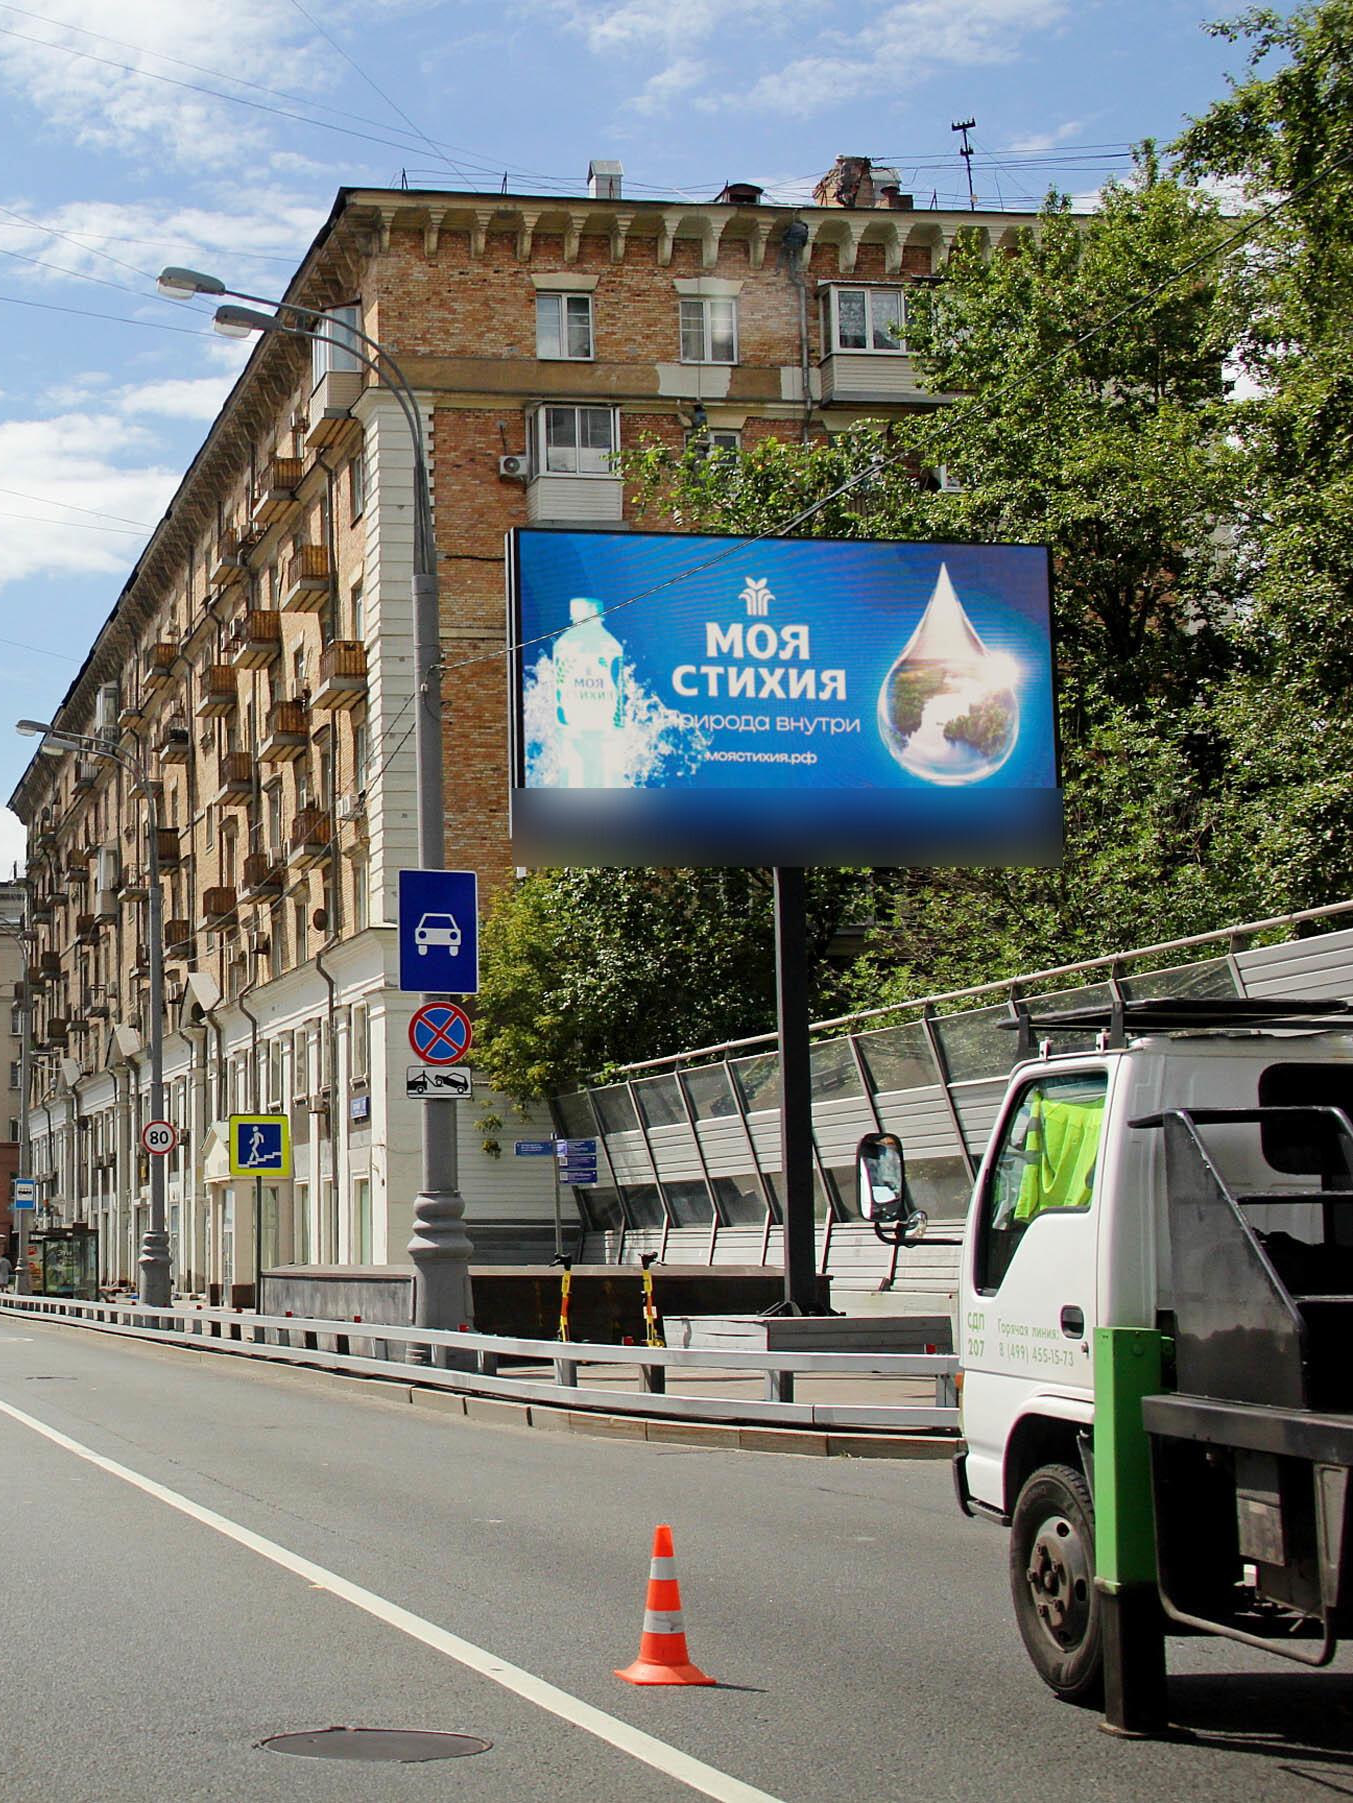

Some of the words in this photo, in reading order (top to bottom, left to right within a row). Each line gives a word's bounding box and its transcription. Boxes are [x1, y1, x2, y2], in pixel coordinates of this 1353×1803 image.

[705, 622, 810, 660] МОЯ
[671, 664, 847, 701] СТИХИЯ
[776, 716, 860, 736] внутри
[706, 751, 817, 766] моястихия.рф
[150, 1131, 169, 1144] 80
[998, 1318, 1029, 1338] Горячая
[967, 1339, 985, 1356] 207
[999, 1342, 1004, 1356] 8
[1007, 1343, 1029, 1364] (499)
[1032, 1346, 1074, 1367] 455-15-73
